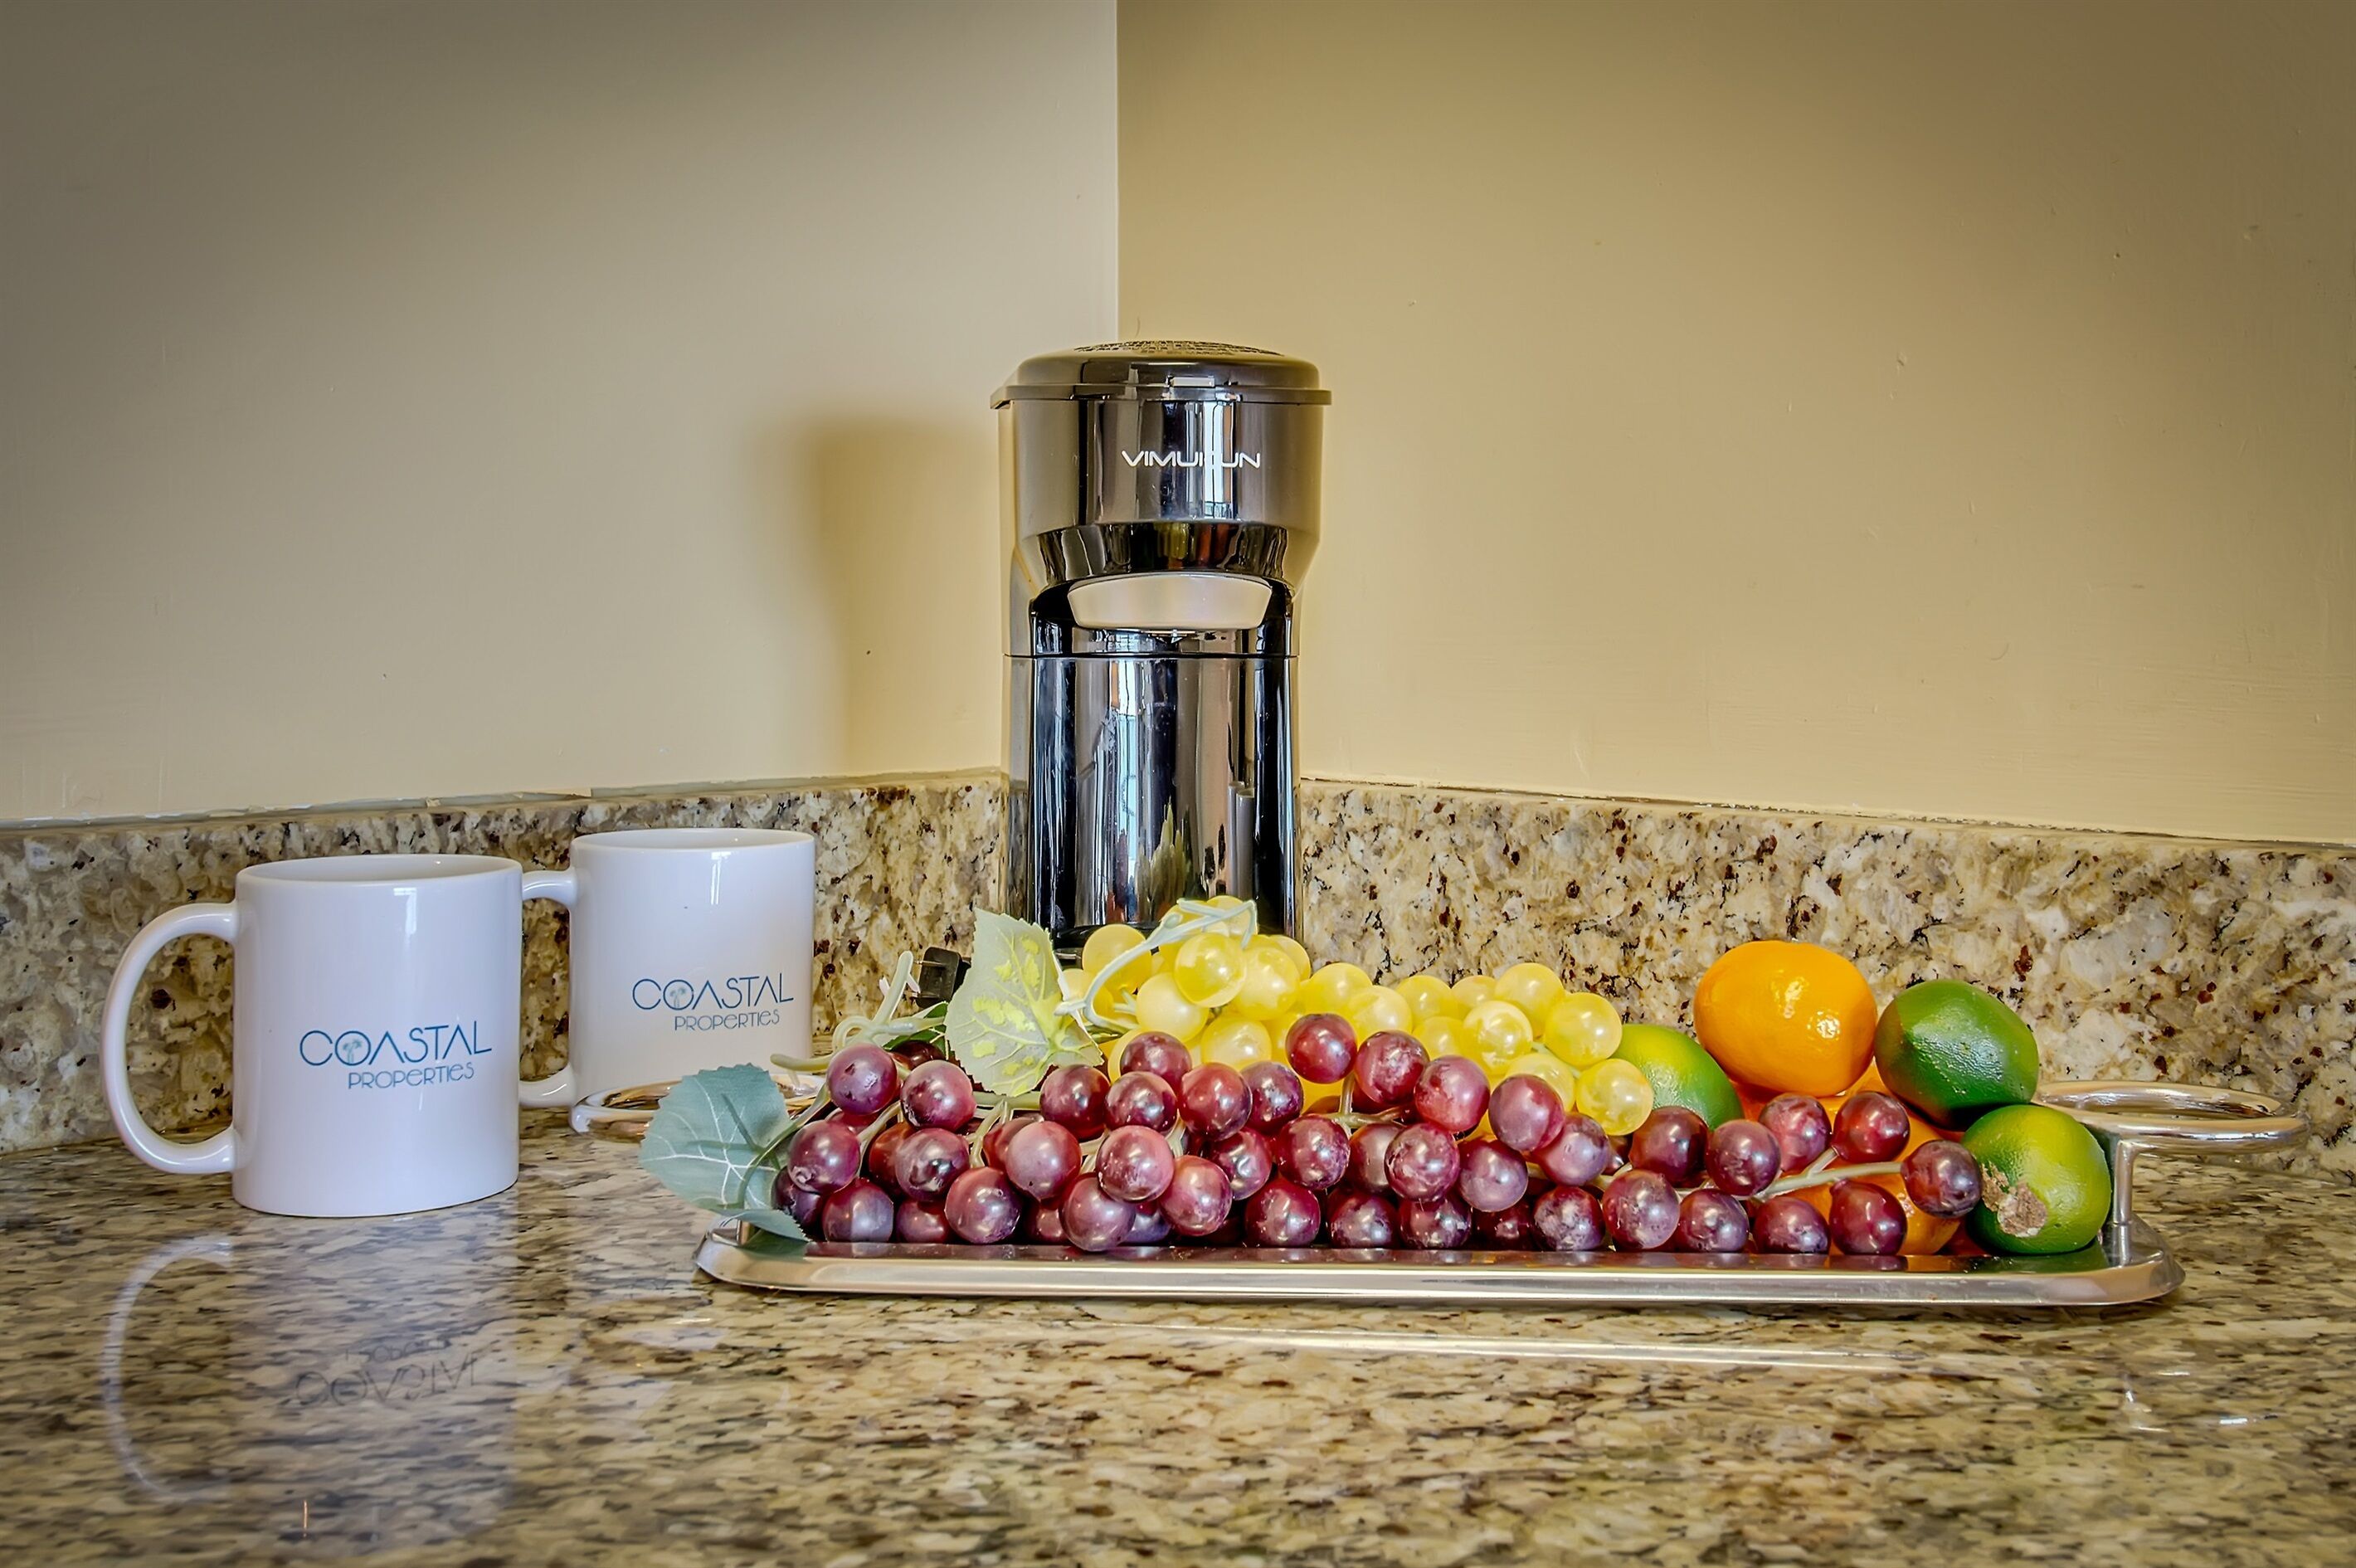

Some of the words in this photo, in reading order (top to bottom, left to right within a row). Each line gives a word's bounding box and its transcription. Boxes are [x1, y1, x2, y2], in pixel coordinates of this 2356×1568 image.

[632, 972, 794, 1010] COASTAL
[674, 1009, 780, 1031] PROPERTIES
[299, 1020, 492, 1066] COASTAL
[348, 1061, 475, 1089] PROPERTIES
